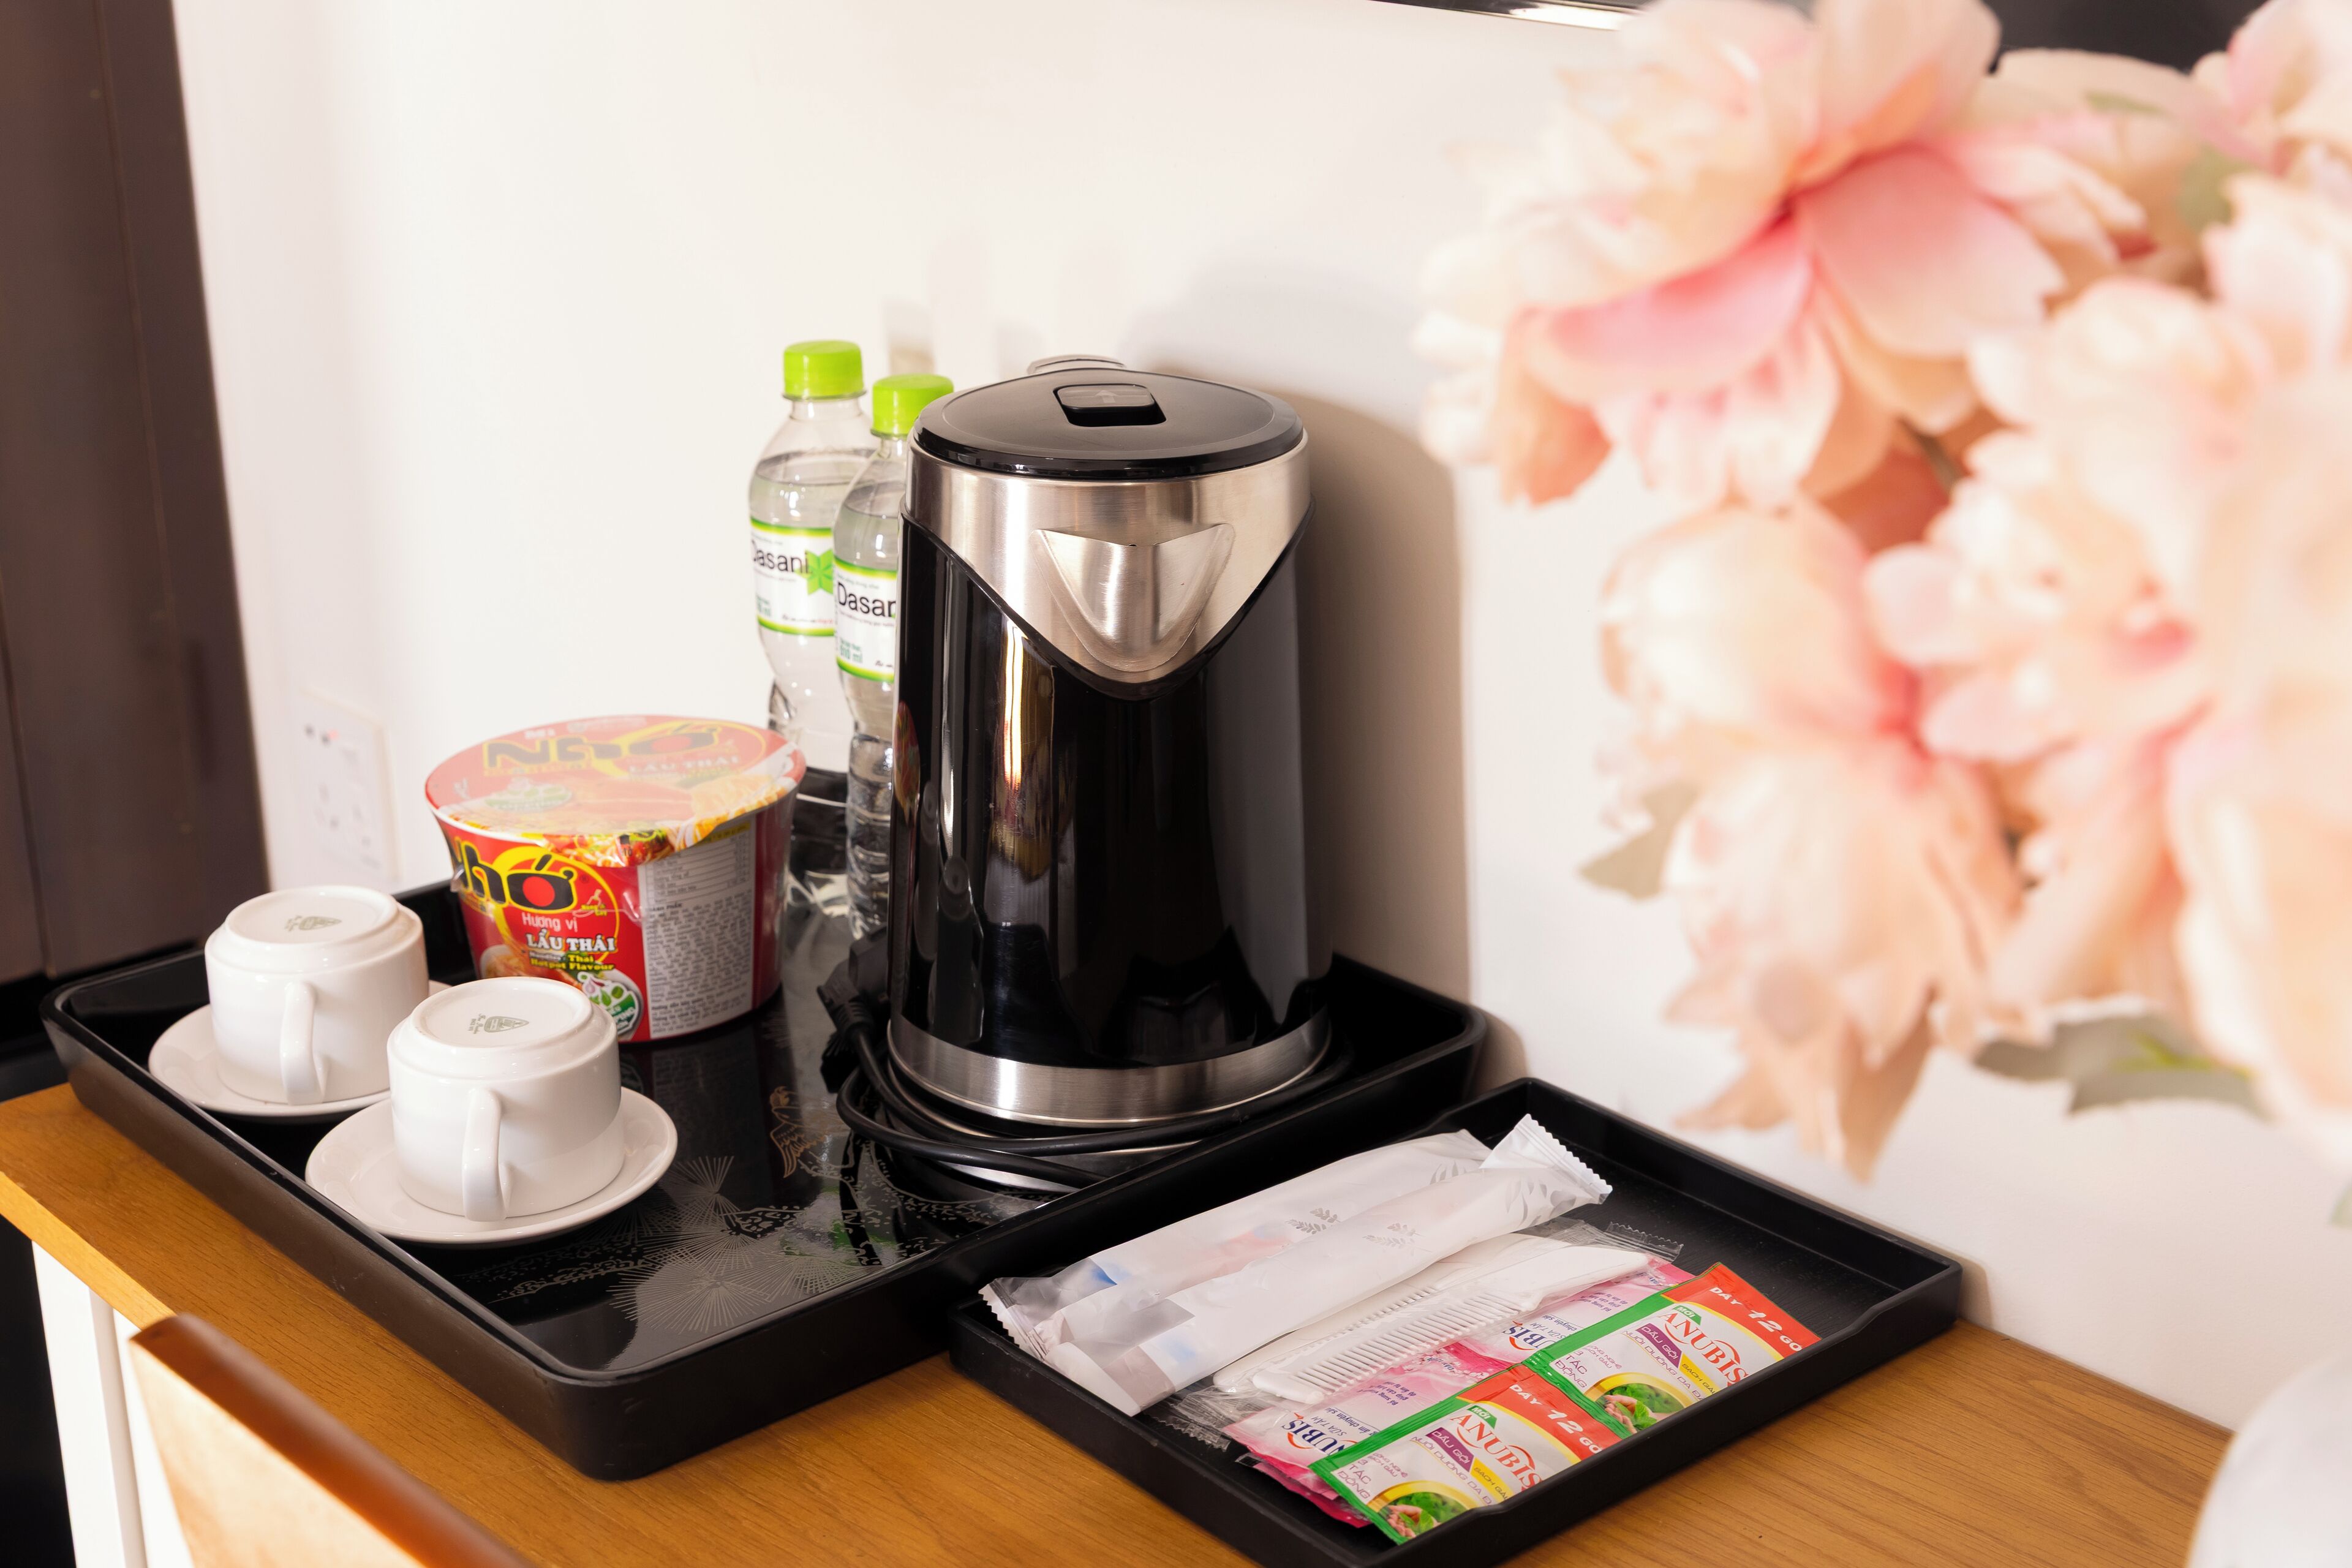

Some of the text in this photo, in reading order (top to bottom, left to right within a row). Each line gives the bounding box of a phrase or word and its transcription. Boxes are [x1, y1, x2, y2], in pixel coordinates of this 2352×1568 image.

[565, 917, 578, 933] vị
[566, 933, 616, 952] THÁI
[1748, 1310, 1783, 1333] 12
[1657, 1312, 1749, 1387] ANUBIS
[1555, 1360, 1588, 1389] ĐỘNG
[1566, 1354, 1588, 1375] TÁC
[1677, 1376, 1691, 1390] DA
[1547, 1409, 1583, 1434] 12
[1450, 1413, 1542, 1491] ANUBIS
[1349, 1464, 1371, 1485] TÁC
[1468, 1480, 1482, 1495] DA
